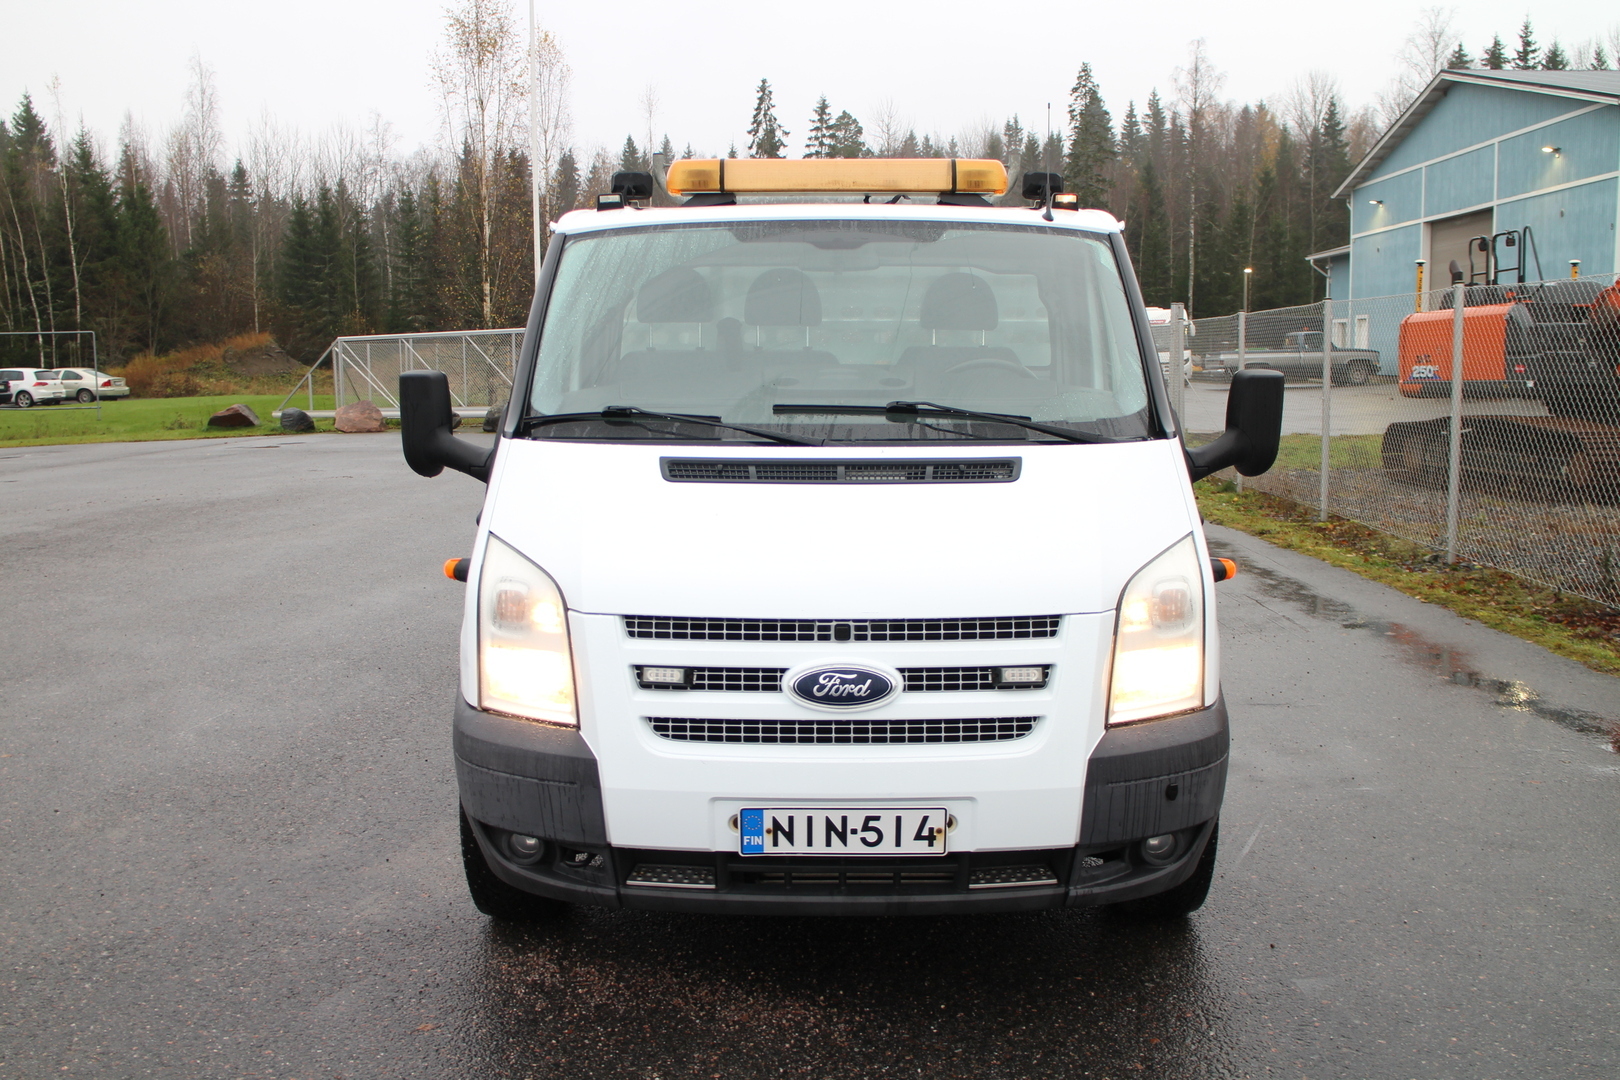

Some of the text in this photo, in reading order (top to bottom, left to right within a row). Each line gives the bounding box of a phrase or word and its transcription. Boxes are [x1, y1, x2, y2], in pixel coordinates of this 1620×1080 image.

[813, 672, 872, 697] Ford
[743, 836, 762, 846] FIN
[772, 815, 937, 848] NIN-514
